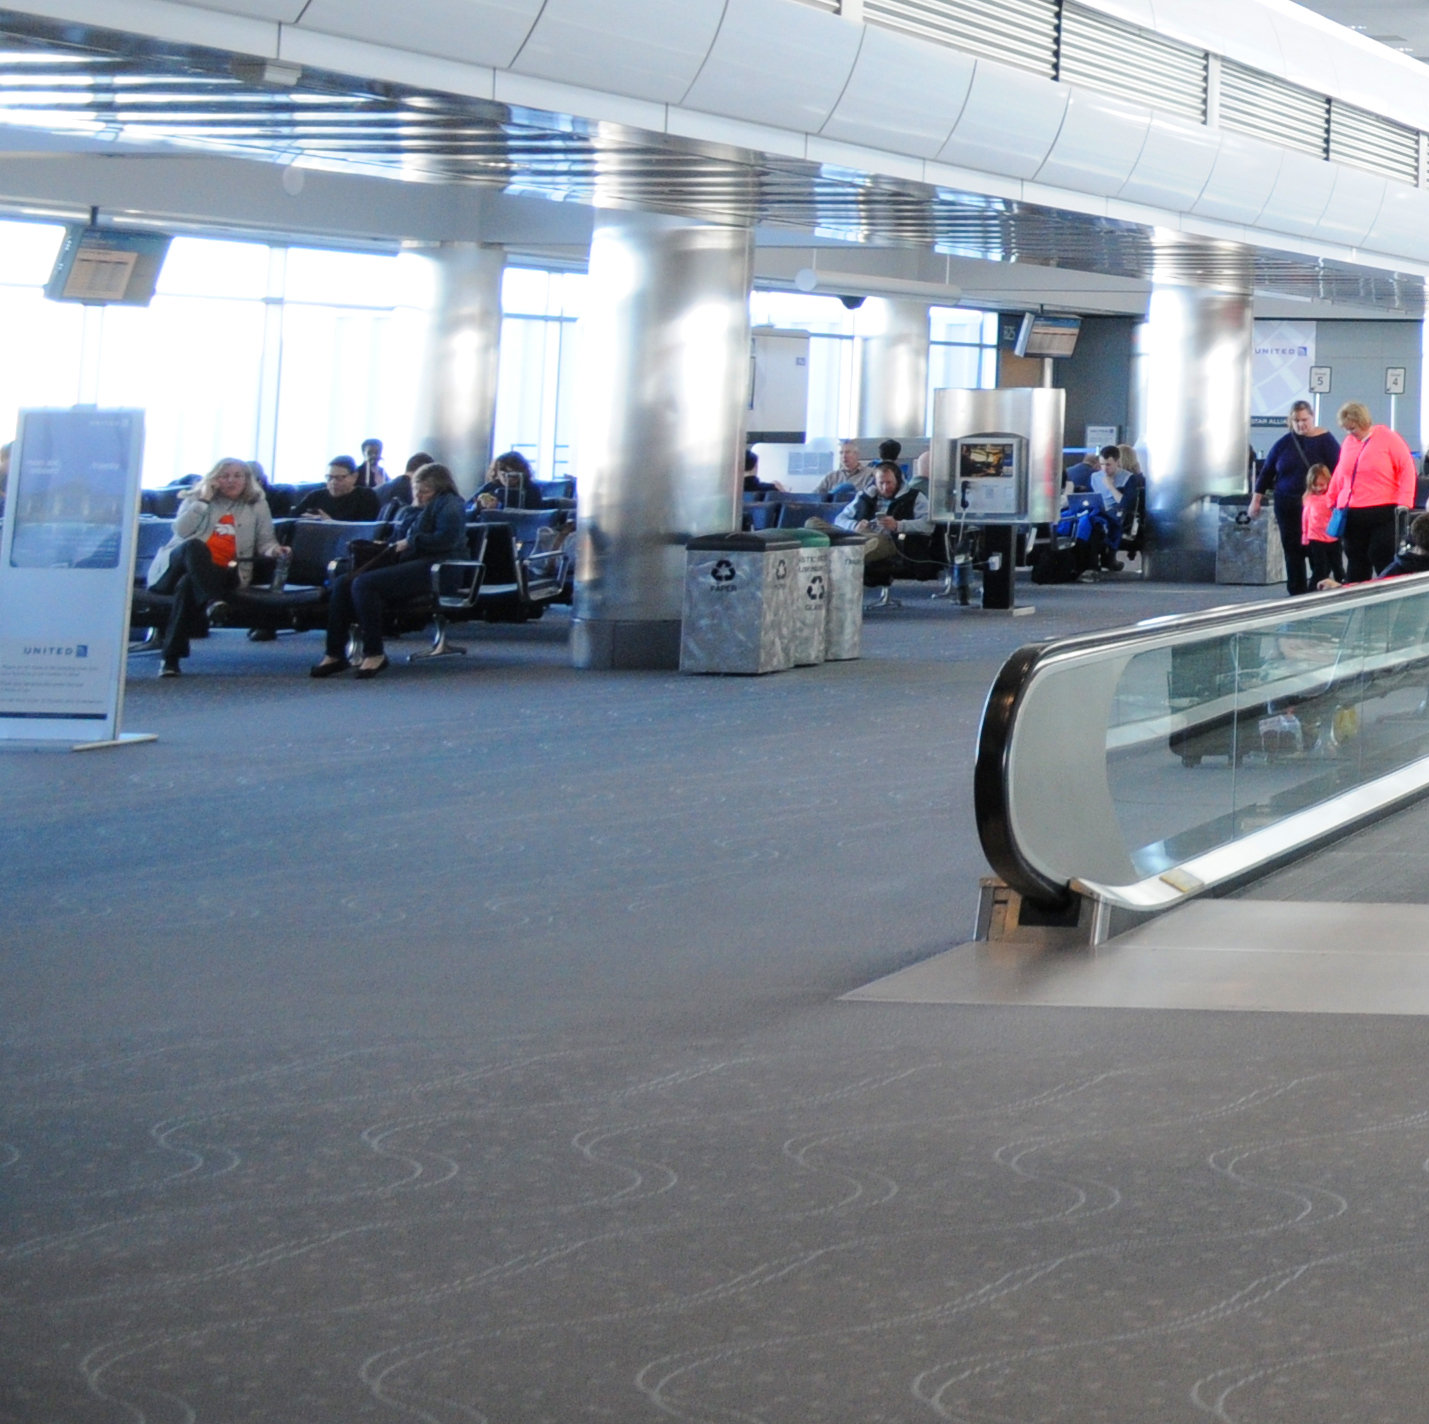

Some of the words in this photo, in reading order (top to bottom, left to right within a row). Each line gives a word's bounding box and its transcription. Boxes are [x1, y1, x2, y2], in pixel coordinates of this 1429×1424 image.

[1317, 377, 1324, 386] 5
[1392, 377, 1399, 386] 4
[710, 585, 737, 593] PAPER
[23, 647, 74, 656] UNITED
